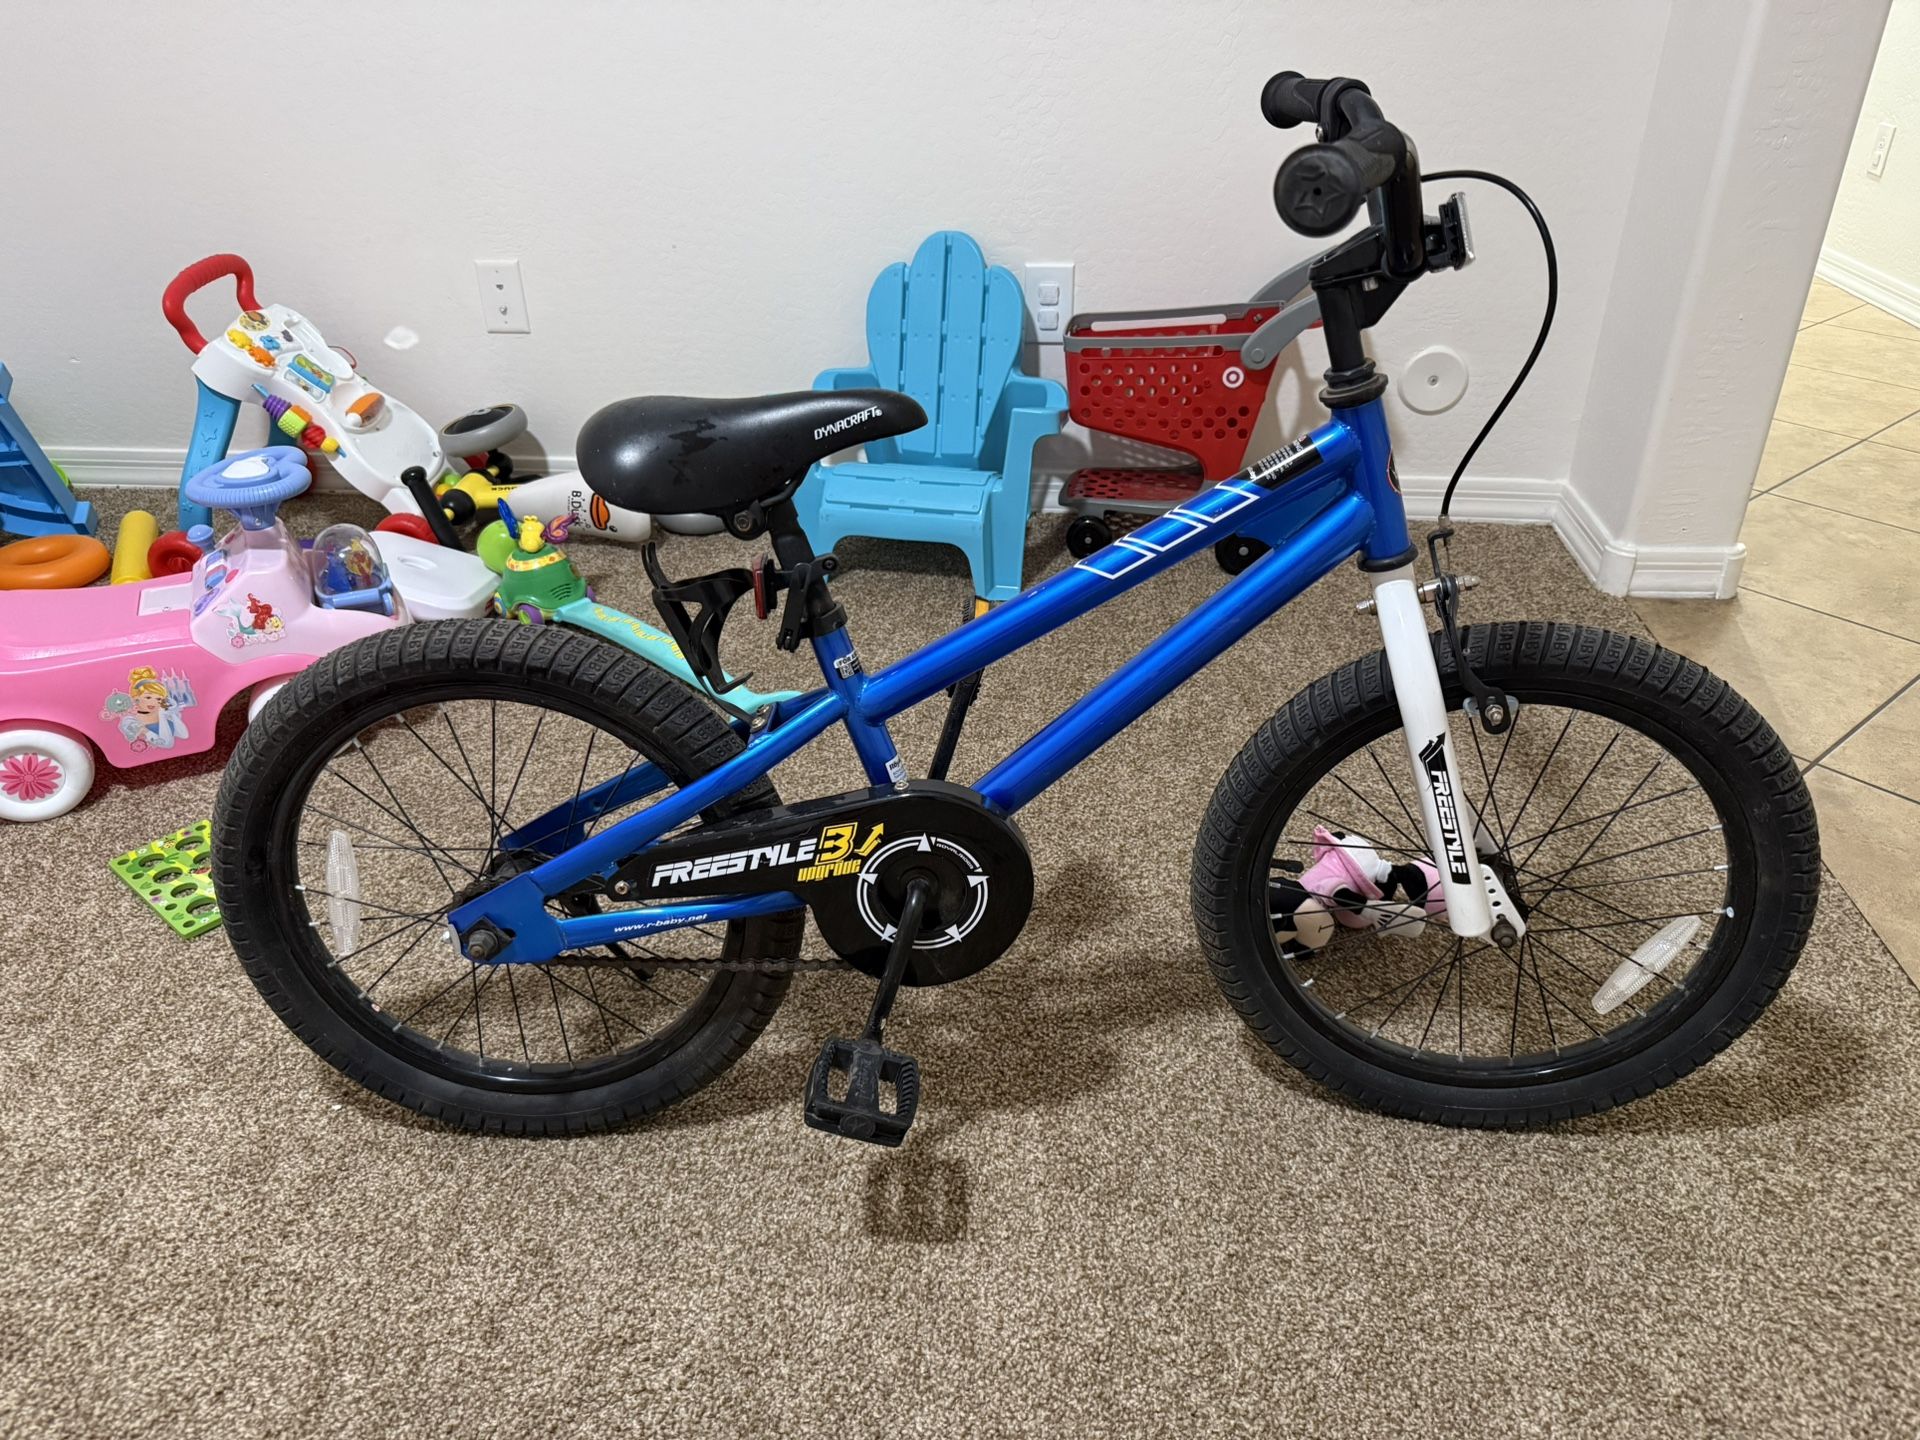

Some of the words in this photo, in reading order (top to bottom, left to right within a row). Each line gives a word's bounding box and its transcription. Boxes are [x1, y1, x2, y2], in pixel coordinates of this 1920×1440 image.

[1431, 770, 1467, 874] FREESTYLE
[651, 838, 818, 887] FREESTYLE
[797, 859, 861, 882] upgrade
[614, 913, 708, 933] www.r-baby.net
